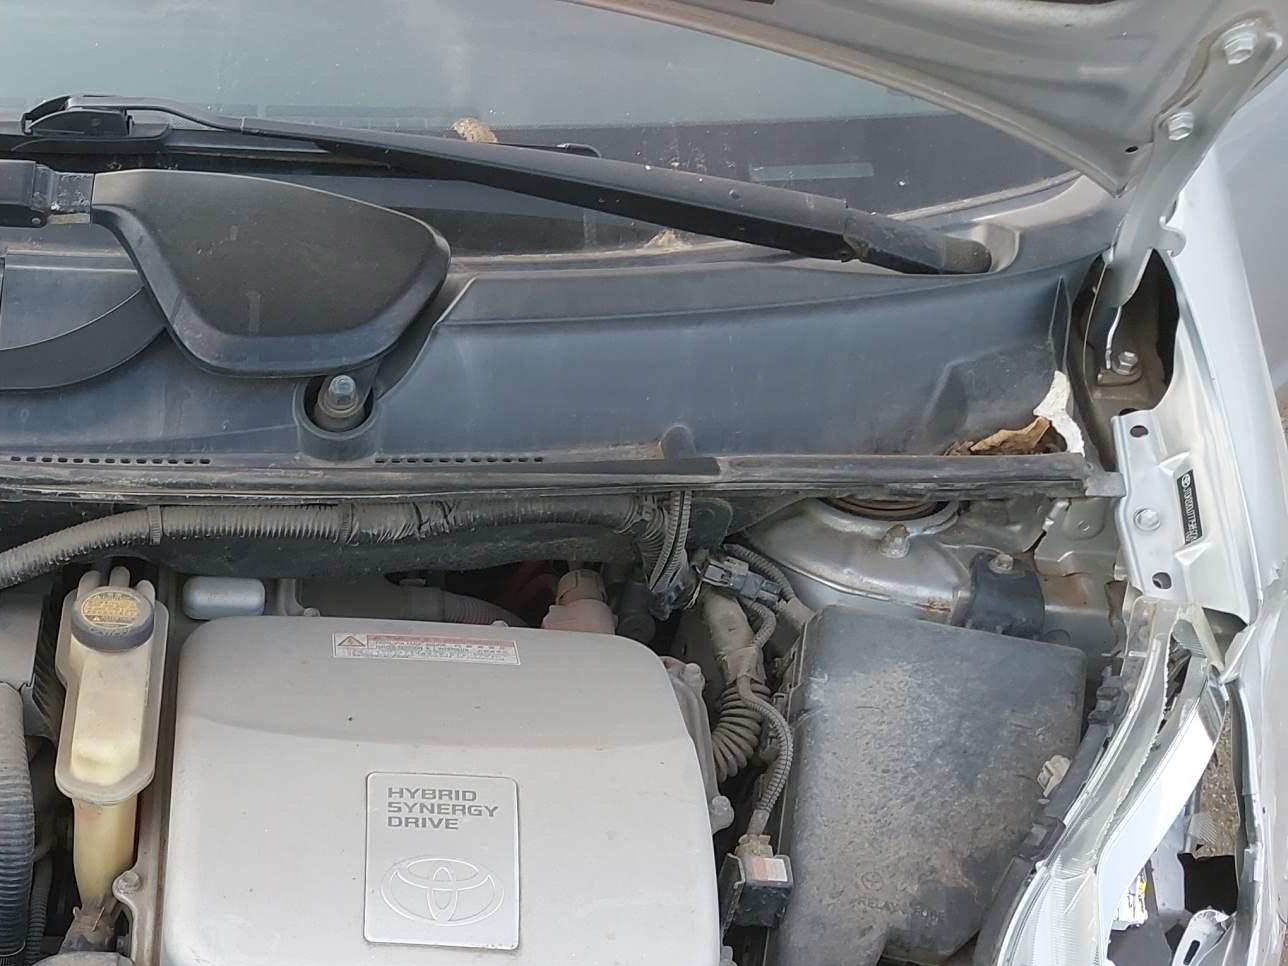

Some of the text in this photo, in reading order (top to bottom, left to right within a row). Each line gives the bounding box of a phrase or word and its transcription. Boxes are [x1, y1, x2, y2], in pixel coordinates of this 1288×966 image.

[387, 787, 477, 802] HYBRID
[387, 801, 499, 817] SYNERGY
[387, 815, 460, 830] DRIVE
